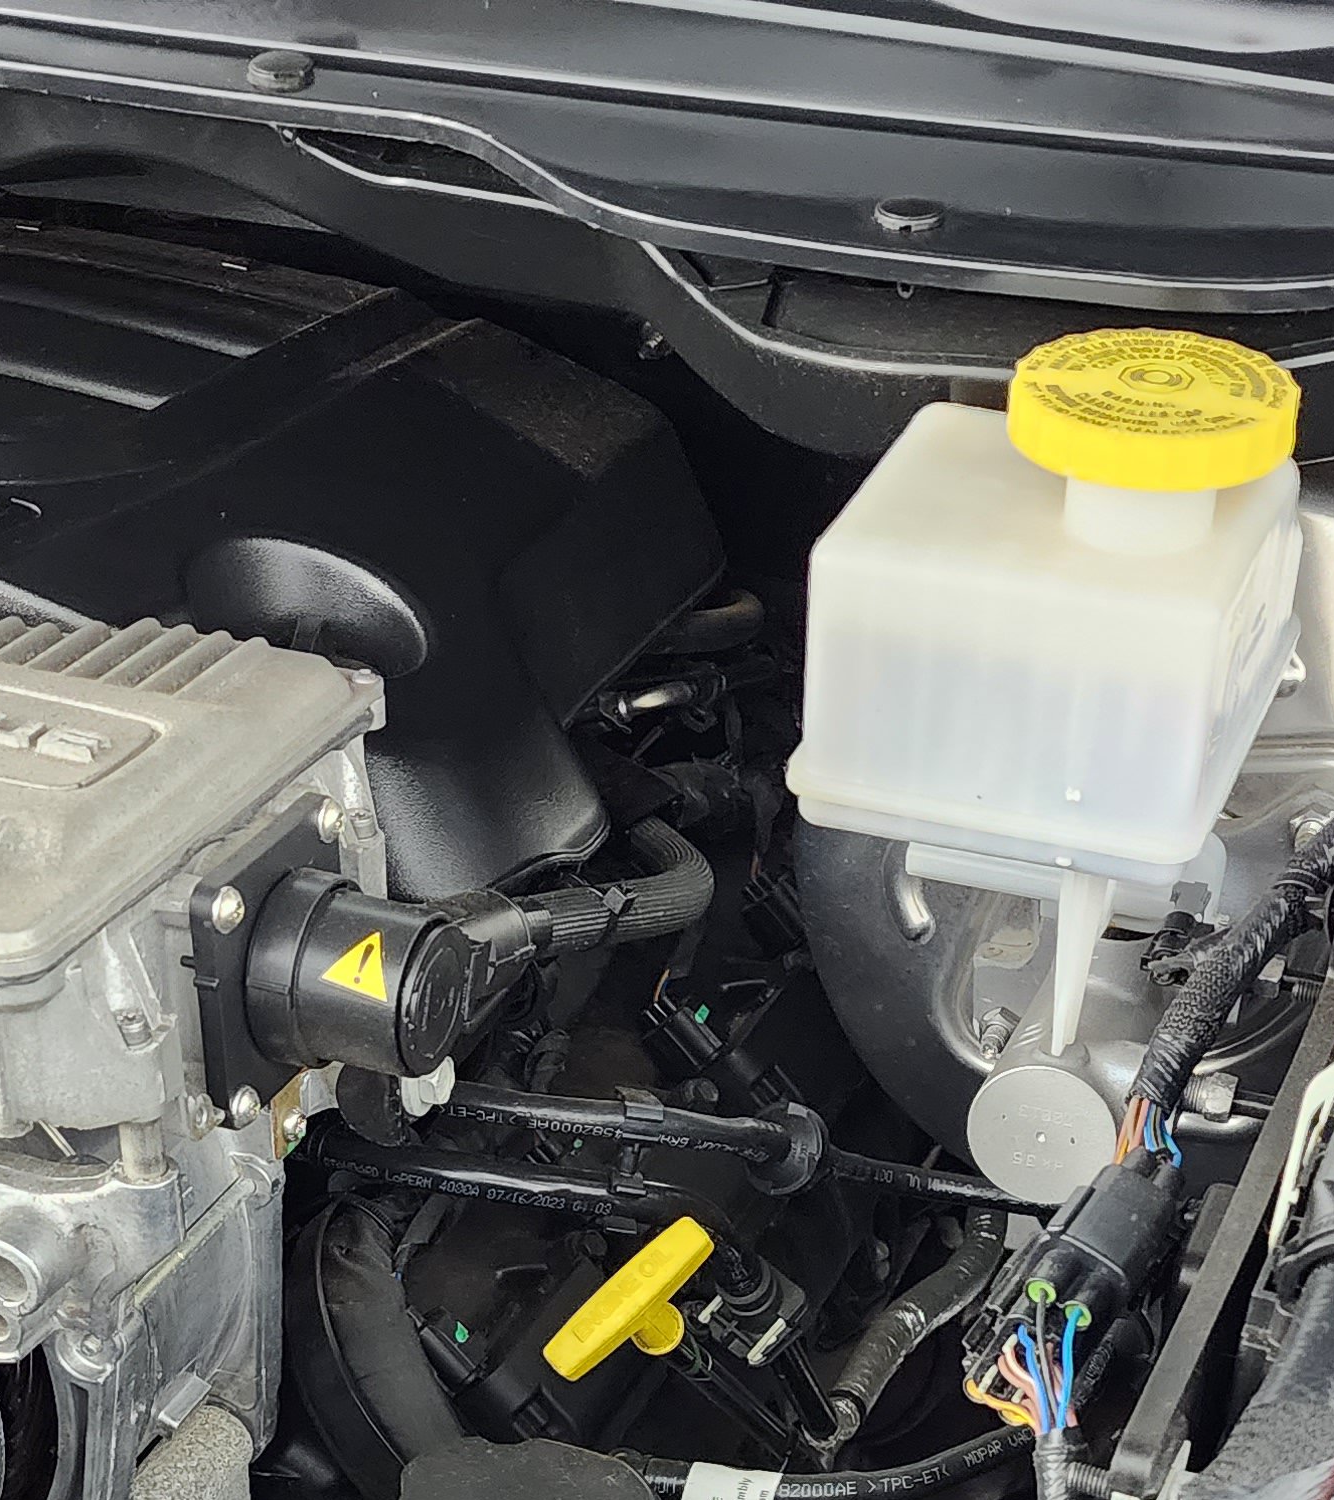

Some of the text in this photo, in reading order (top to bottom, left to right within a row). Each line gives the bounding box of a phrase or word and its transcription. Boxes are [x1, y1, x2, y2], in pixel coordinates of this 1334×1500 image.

[572, 1249, 675, 1343] ENGINE OIL
[963, 1439, 1004, 1467] MOPAR
